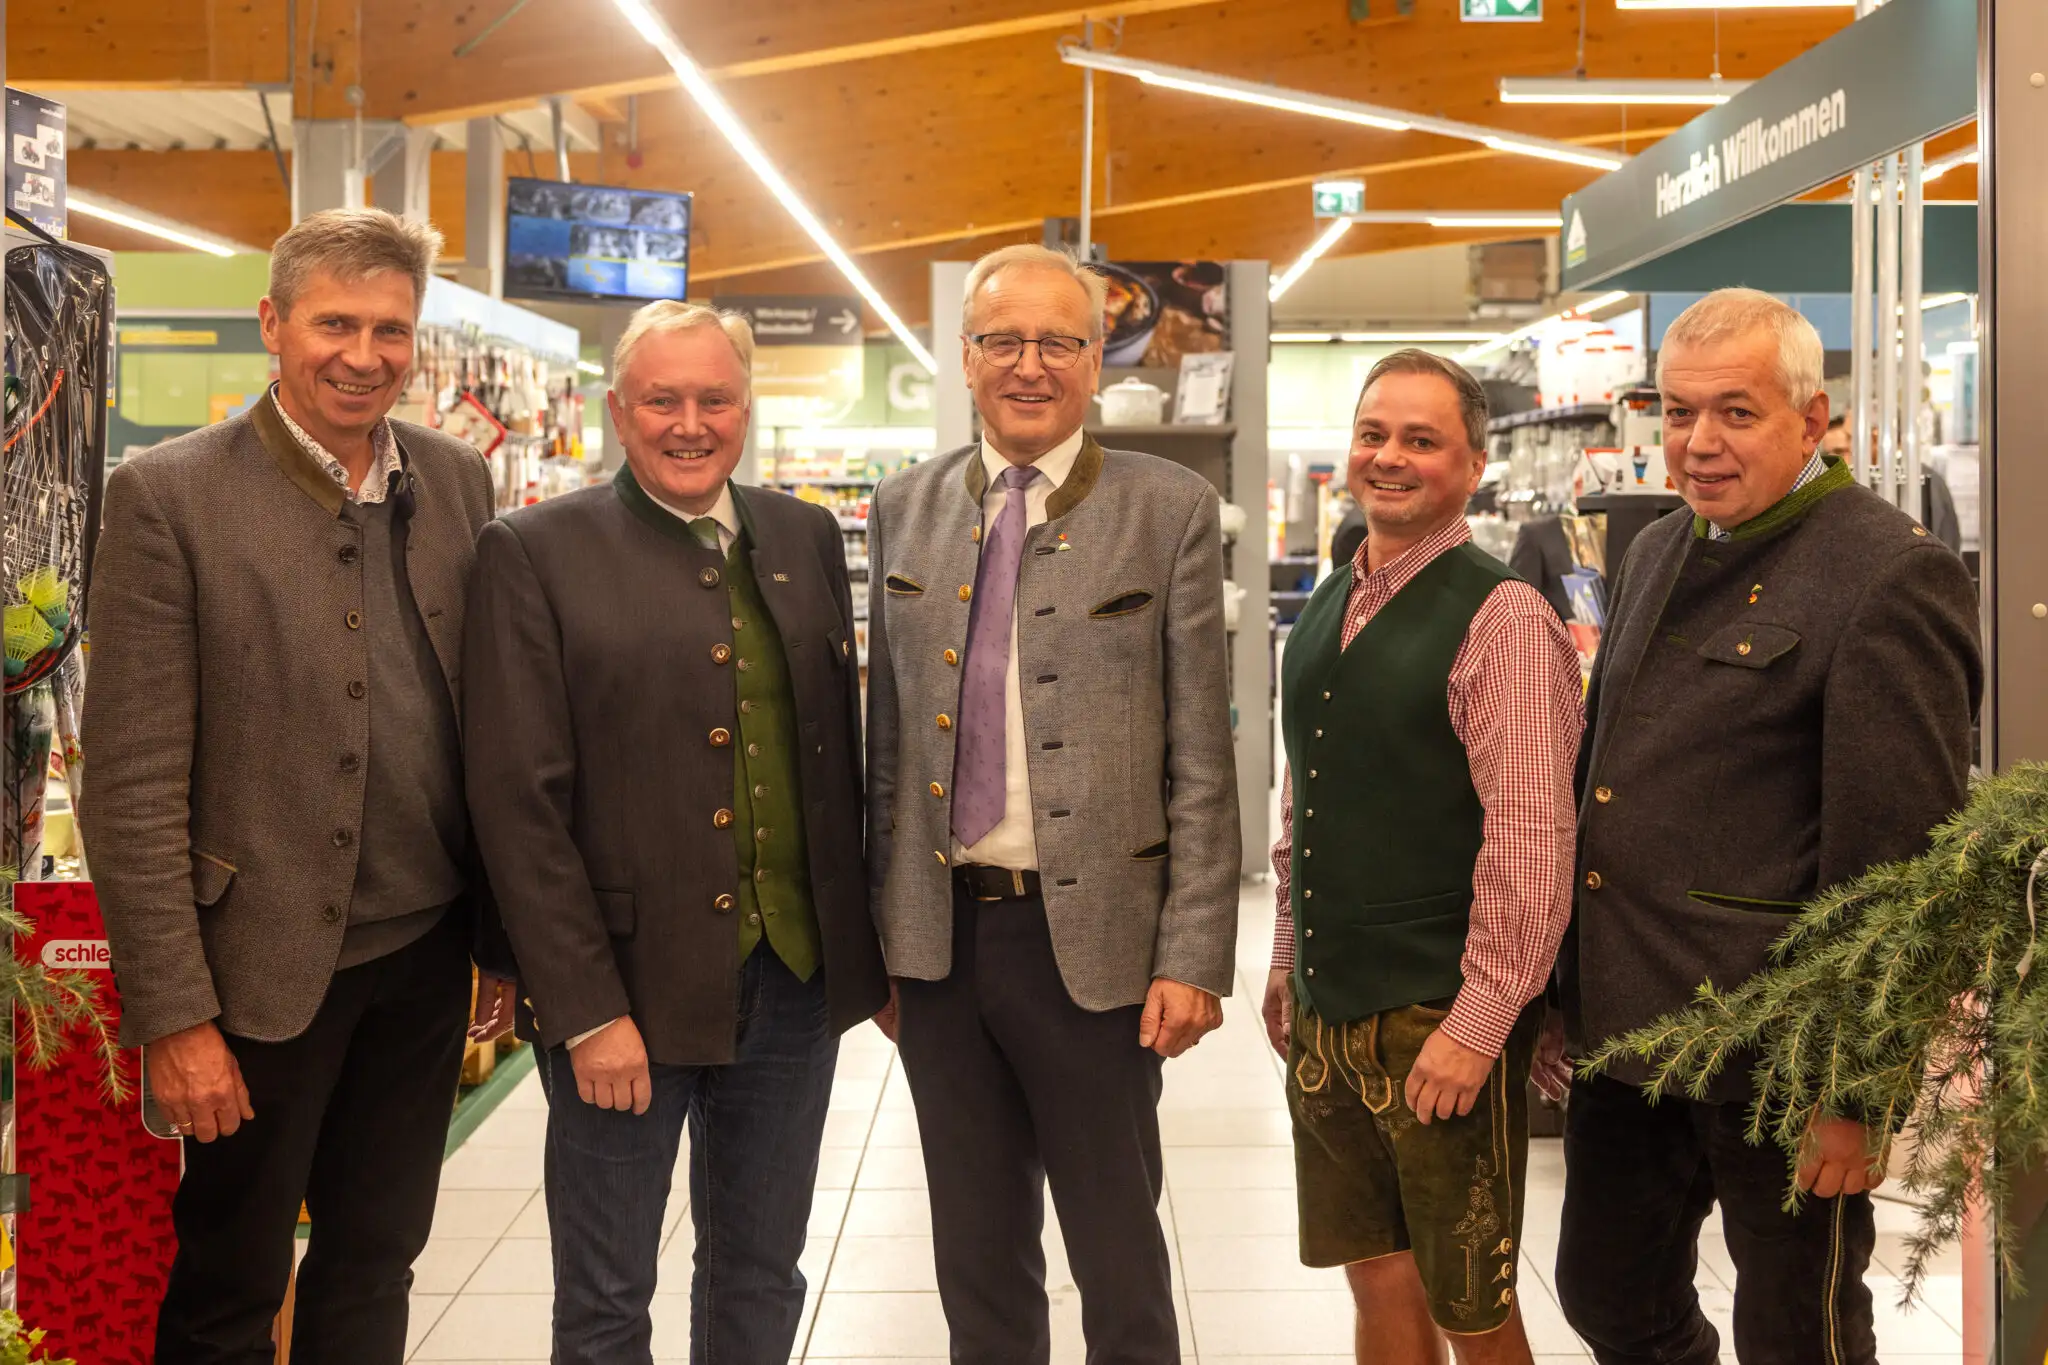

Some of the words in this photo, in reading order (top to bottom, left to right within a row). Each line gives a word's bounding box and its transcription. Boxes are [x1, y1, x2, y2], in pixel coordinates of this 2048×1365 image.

[1656, 144, 1720, 218] Herzlich
[1722, 89, 1846, 184] Willkommen
[55, 944, 110, 962] schle
